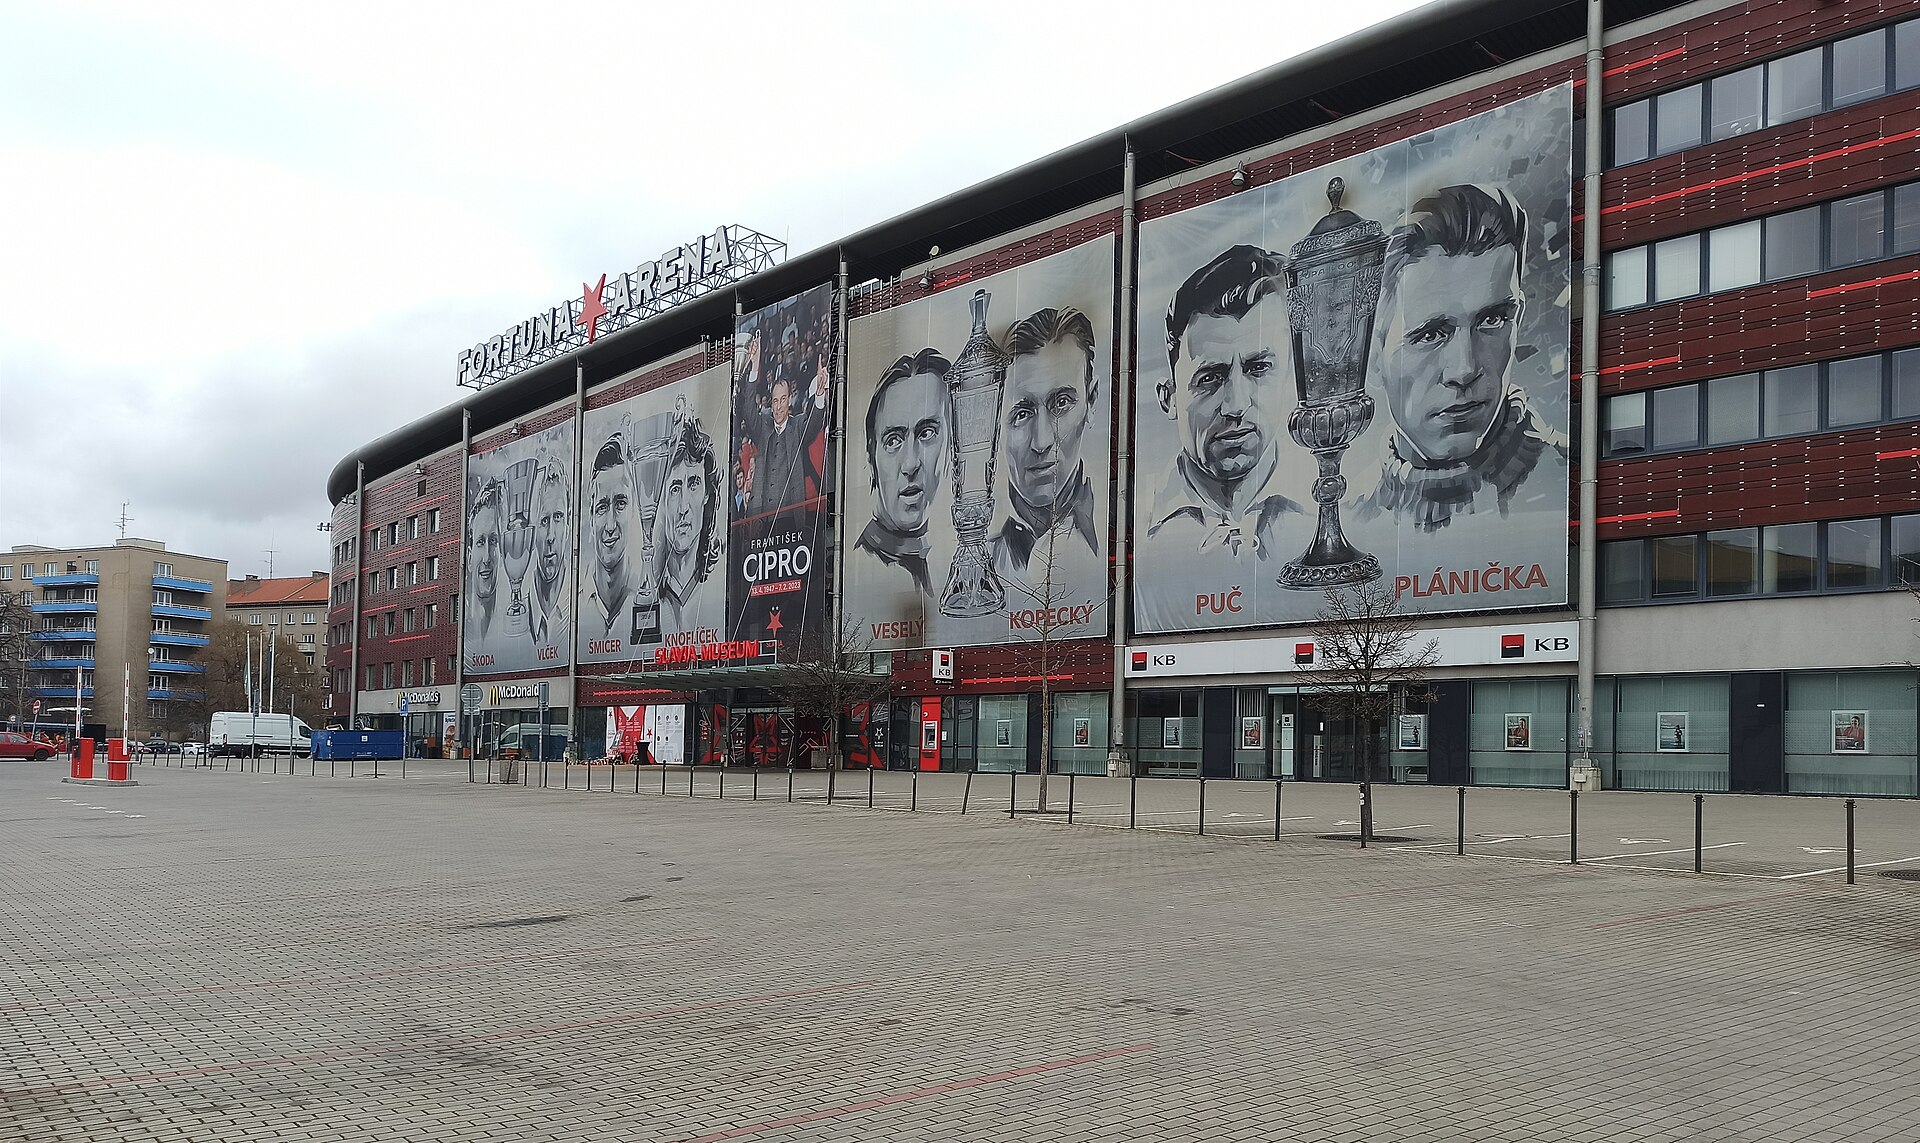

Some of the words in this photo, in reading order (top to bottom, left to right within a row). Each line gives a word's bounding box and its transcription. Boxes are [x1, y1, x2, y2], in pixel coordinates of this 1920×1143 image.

[456, 300, 574, 386] FORTUNA
[611, 225, 732, 317] ARENA
[751, 531, 803, 549] FRANTIŠEK
[743, 546, 809, 581] CIPRO
[1395, 562, 1548, 598] PLÁNIČKA
[1196, 585, 1243, 615] PUČ
[1009, 600, 1094, 630] KOPECKÝ
[664, 626, 719, 648] KNOFLÍČEK
[871, 616, 924, 640] VESELÝ
[537, 645, 559, 661] VLČEK
[588, 638, 622, 655] ŠMICER
[654, 645, 697, 665] SLAVIA
[701, 639, 760, 661] MUSEUM
[1534, 637, 1570, 652] KB
[472, 653, 495, 667] ŠKODA
[1153, 654, 1176, 667] KB
[938, 668, 951, 676] KB
[500, 684, 540, 698] McDonald
[401, 699, 407, 710] P
